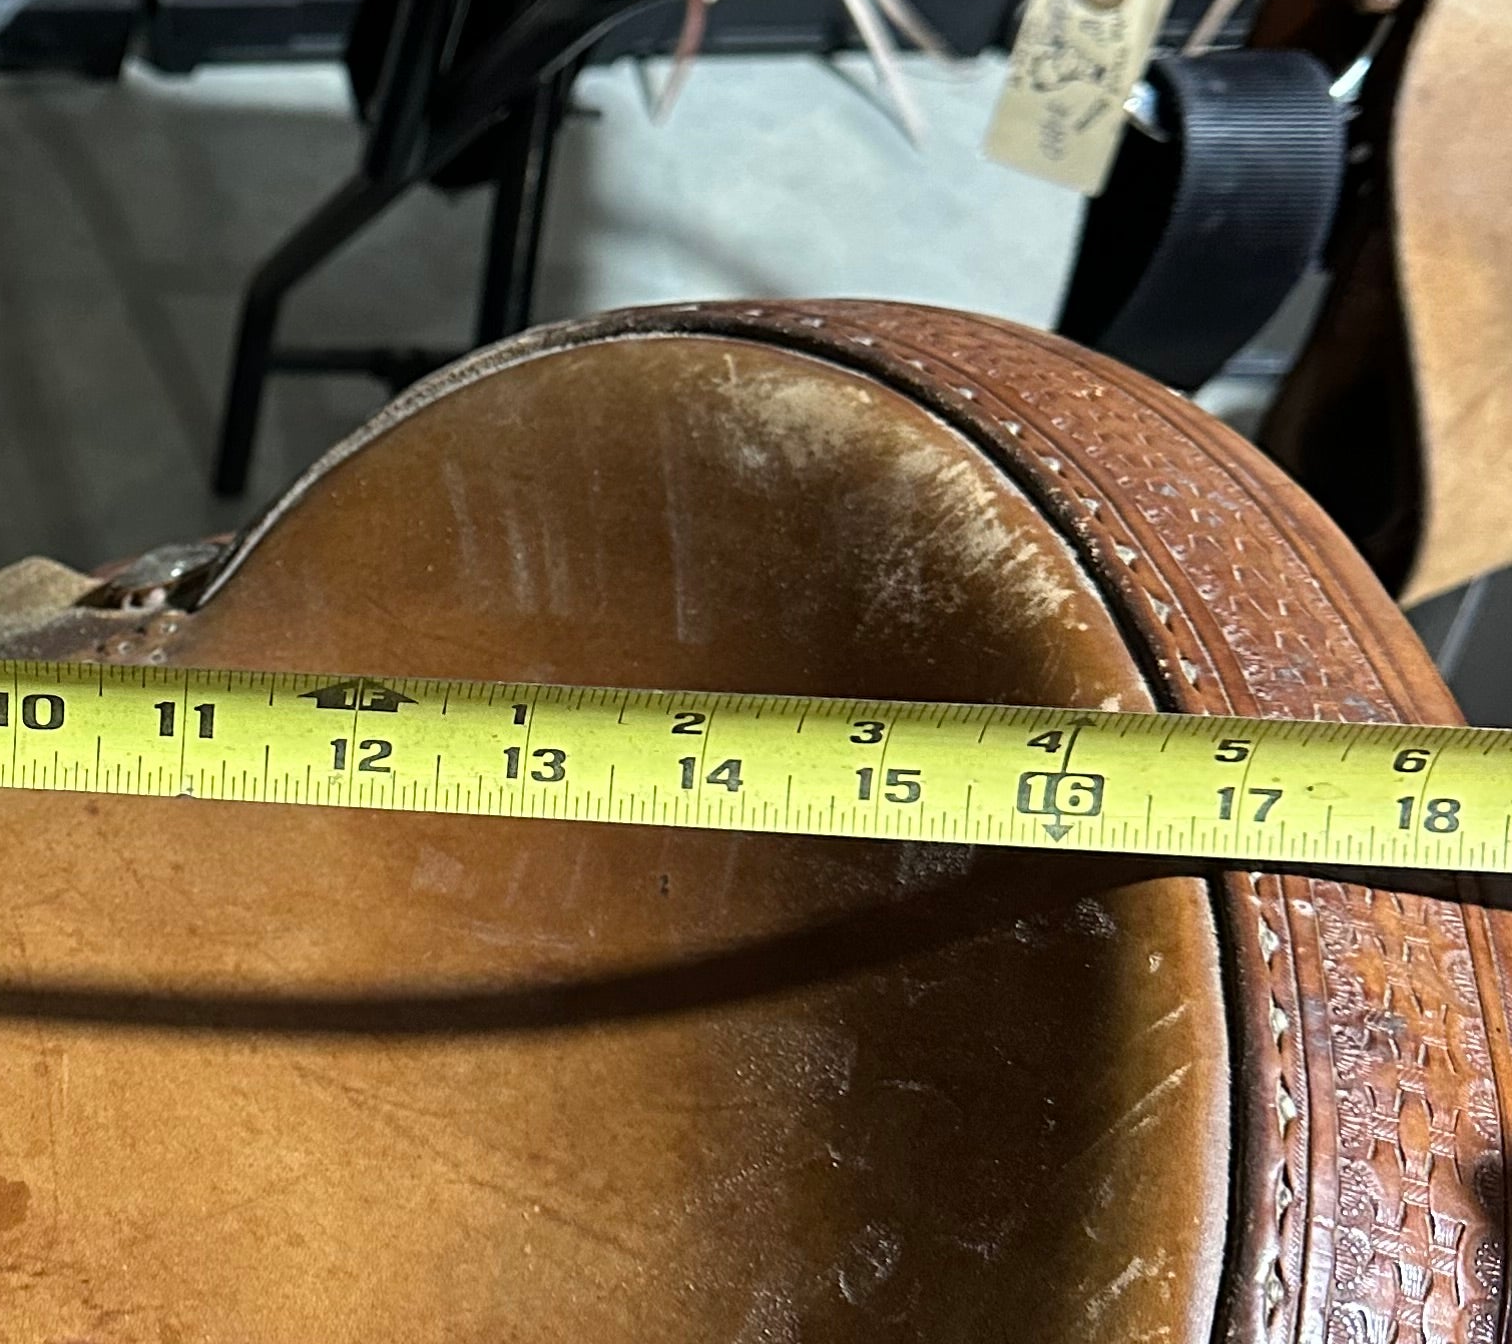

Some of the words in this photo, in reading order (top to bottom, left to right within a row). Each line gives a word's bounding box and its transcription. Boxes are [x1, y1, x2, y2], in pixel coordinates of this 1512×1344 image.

[343, 688, 386, 707] 1F
[154, 701, 215, 739] 11
[330, 738, 392, 773] 12
[503, 746, 567, 782] 13
[678, 756, 743, 793] 14
[855, 767, 922, 804] 15
[1025, 773, 1095, 815] 16
[1216, 786, 1283, 823] 17
[1396, 796, 1461, 834] 18
[511, 703, 528, 725] 1
[671, 712, 707, 735] 2
[849, 721, 886, 745] 3
[1027, 730, 1064, 754] 4
[1213, 739, 1252, 763] 5
[1392, 748, 1431, 773] 6
